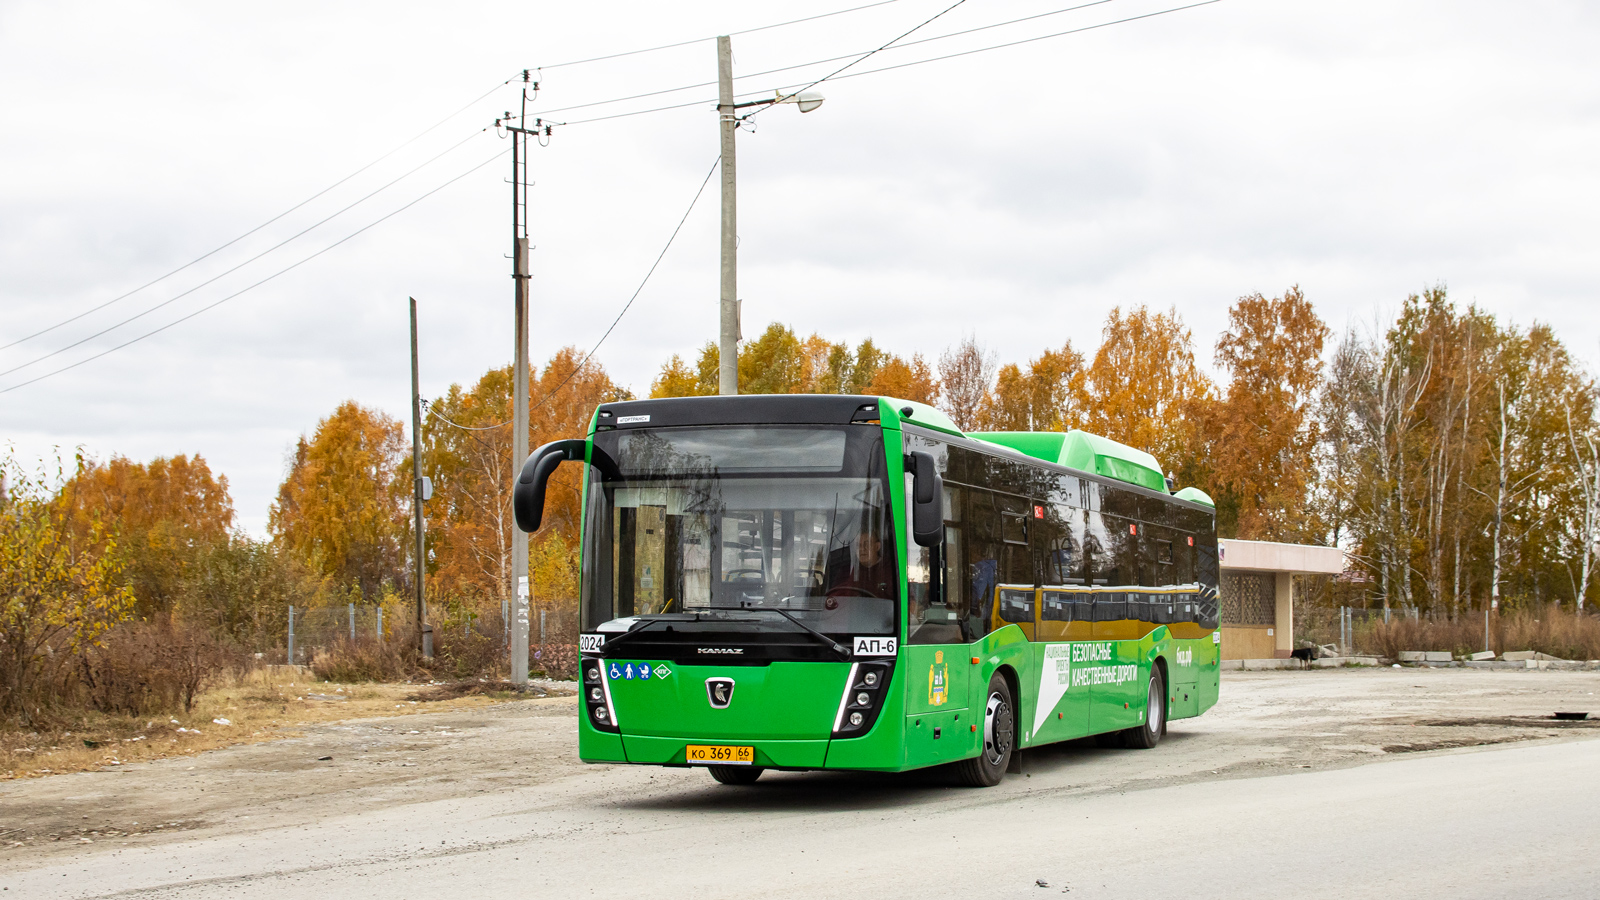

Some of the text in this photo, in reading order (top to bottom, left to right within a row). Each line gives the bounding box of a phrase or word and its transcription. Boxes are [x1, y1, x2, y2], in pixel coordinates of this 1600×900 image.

[581, 636, 602, 650] 2024
[856, 639, 895, 653] АП-6
[697, 647, 744, 655] KAMAZ
[1072, 643, 1112, 662] БЕЗОПАСНЫЕ
[1072, 664, 1138, 686] КАЧЕСТВЕННЫЕ ДОРОГИ
[710, 748, 732, 760] 369
[738, 748, 750, 756] 66
